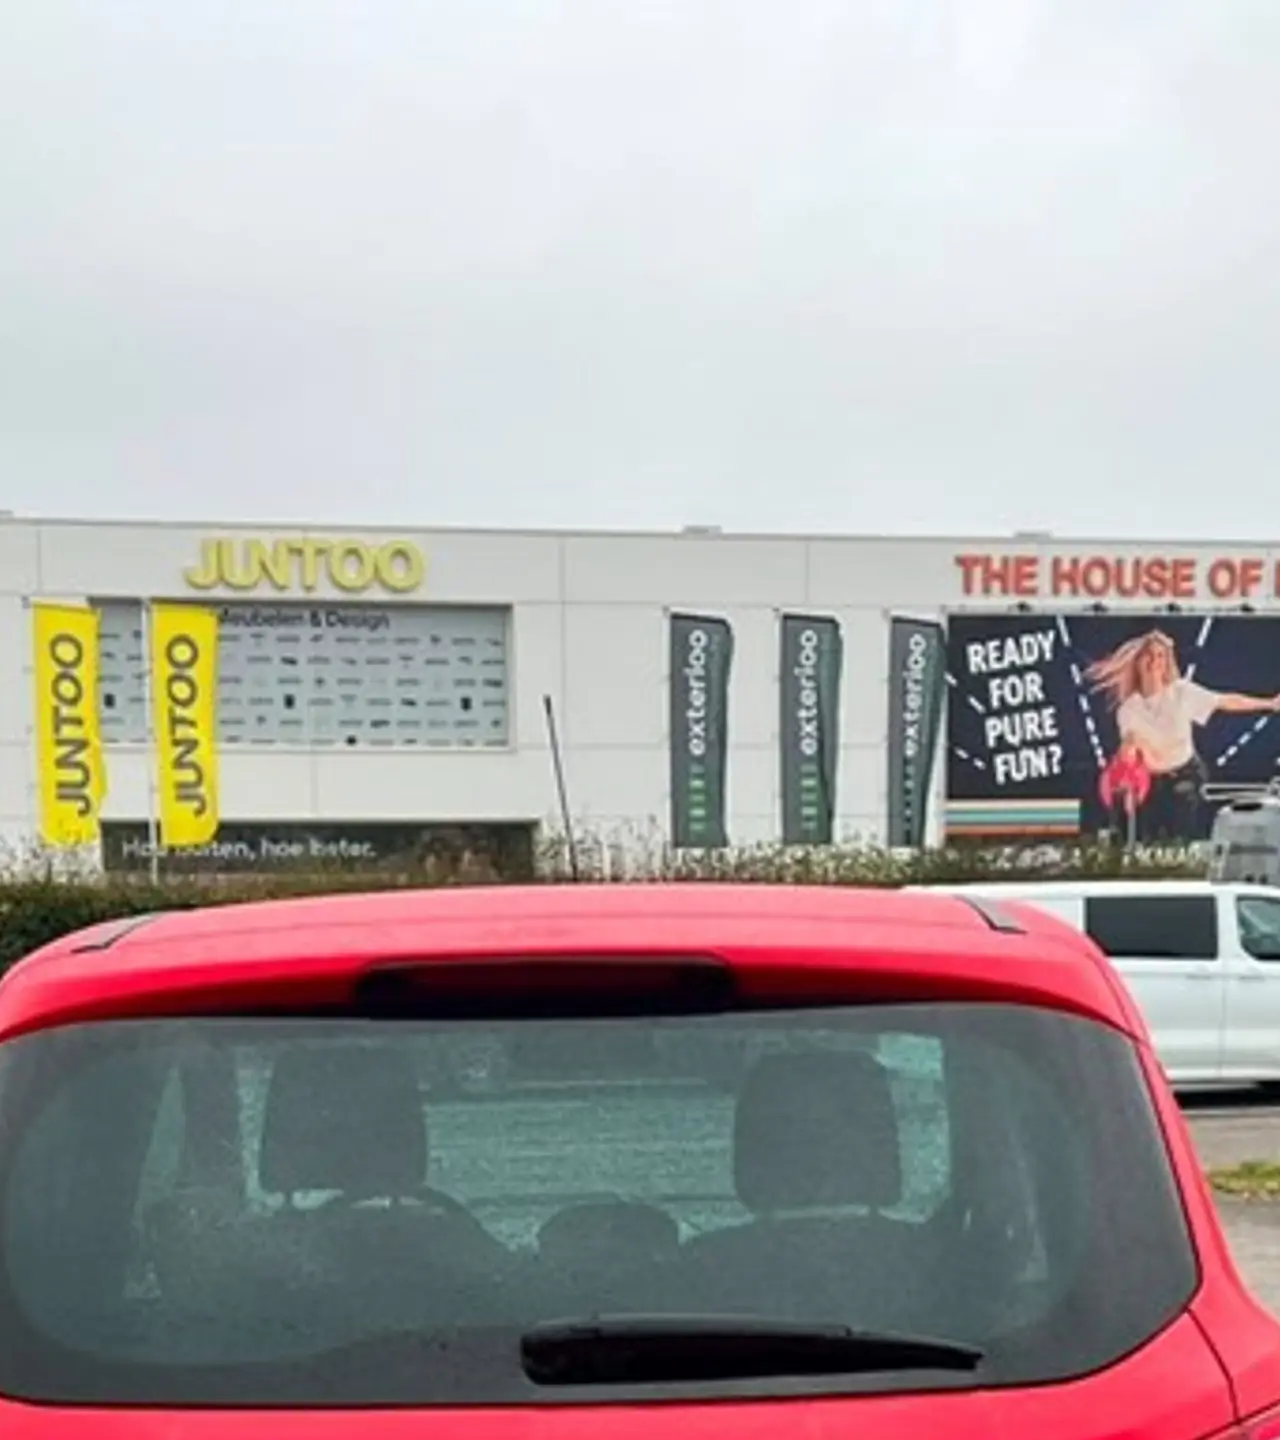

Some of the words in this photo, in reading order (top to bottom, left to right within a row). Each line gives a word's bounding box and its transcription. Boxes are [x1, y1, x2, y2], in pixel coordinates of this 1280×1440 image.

[184, 538, 424, 594] JUNTOO
[955, 555, 1040, 595] THE
[1051, 559, 1196, 597] HOUSE
[1207, 561, 1264, 598] OF
[966, 630, 1055, 674] READY
[683, 629, 708, 756] exterioo
[794, 629, 819, 756] exterioo
[902, 633, 928, 758] exterioo
[988, 673, 1045, 709] FOR
[49, 633, 92, 818] JUNTOO
[166, 634, 208, 818] JUNTOO
[984, 708, 1059, 748] PURE
[994, 745, 1063, 784] FUN?
